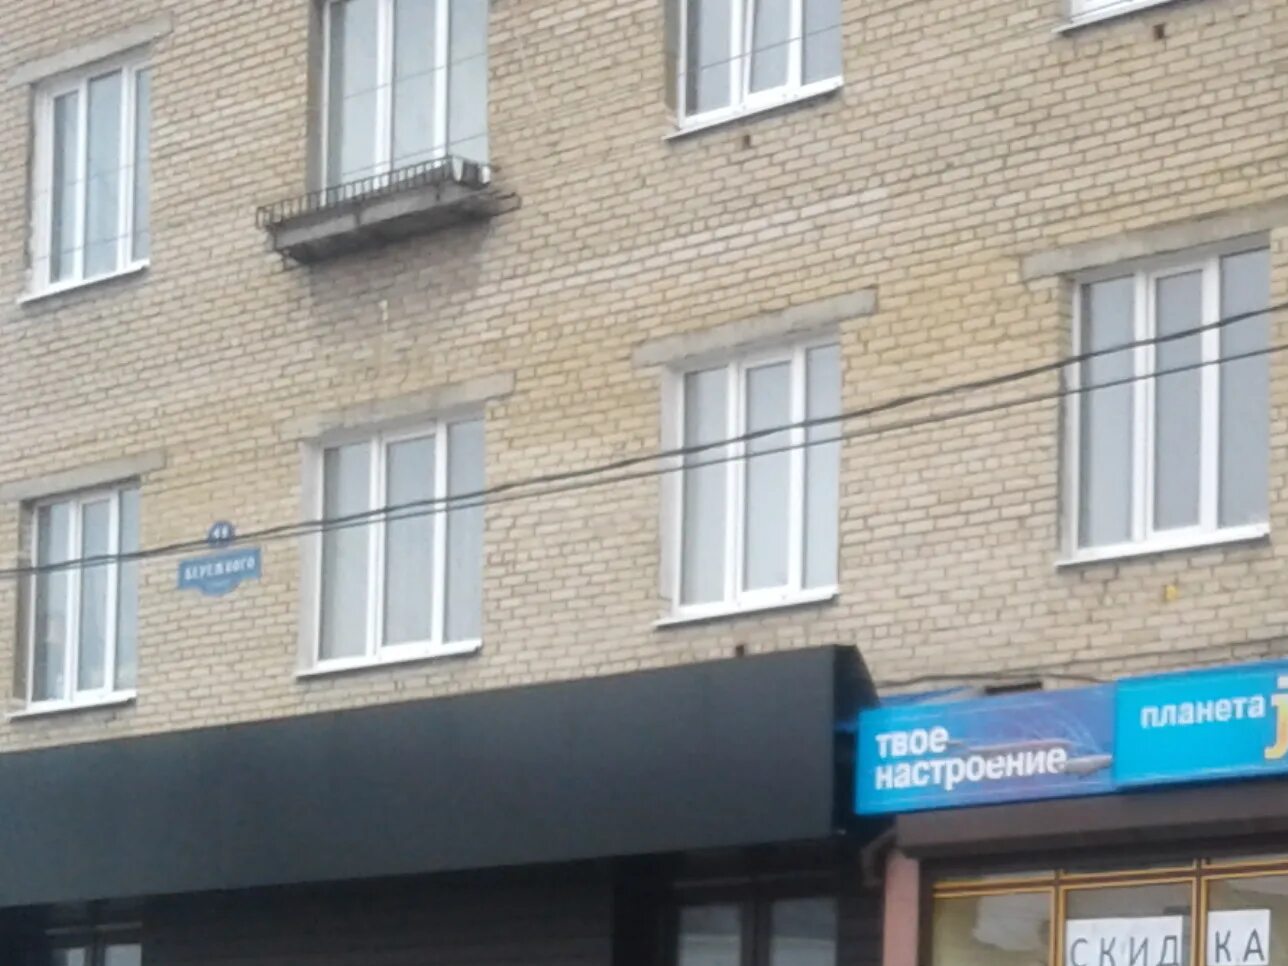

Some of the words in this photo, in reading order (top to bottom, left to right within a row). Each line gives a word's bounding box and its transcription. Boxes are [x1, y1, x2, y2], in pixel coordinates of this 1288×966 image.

[1140, 694, 1266, 729] планета
[875, 726, 949, 759] твое
[875, 745, 1067, 791] настроение
